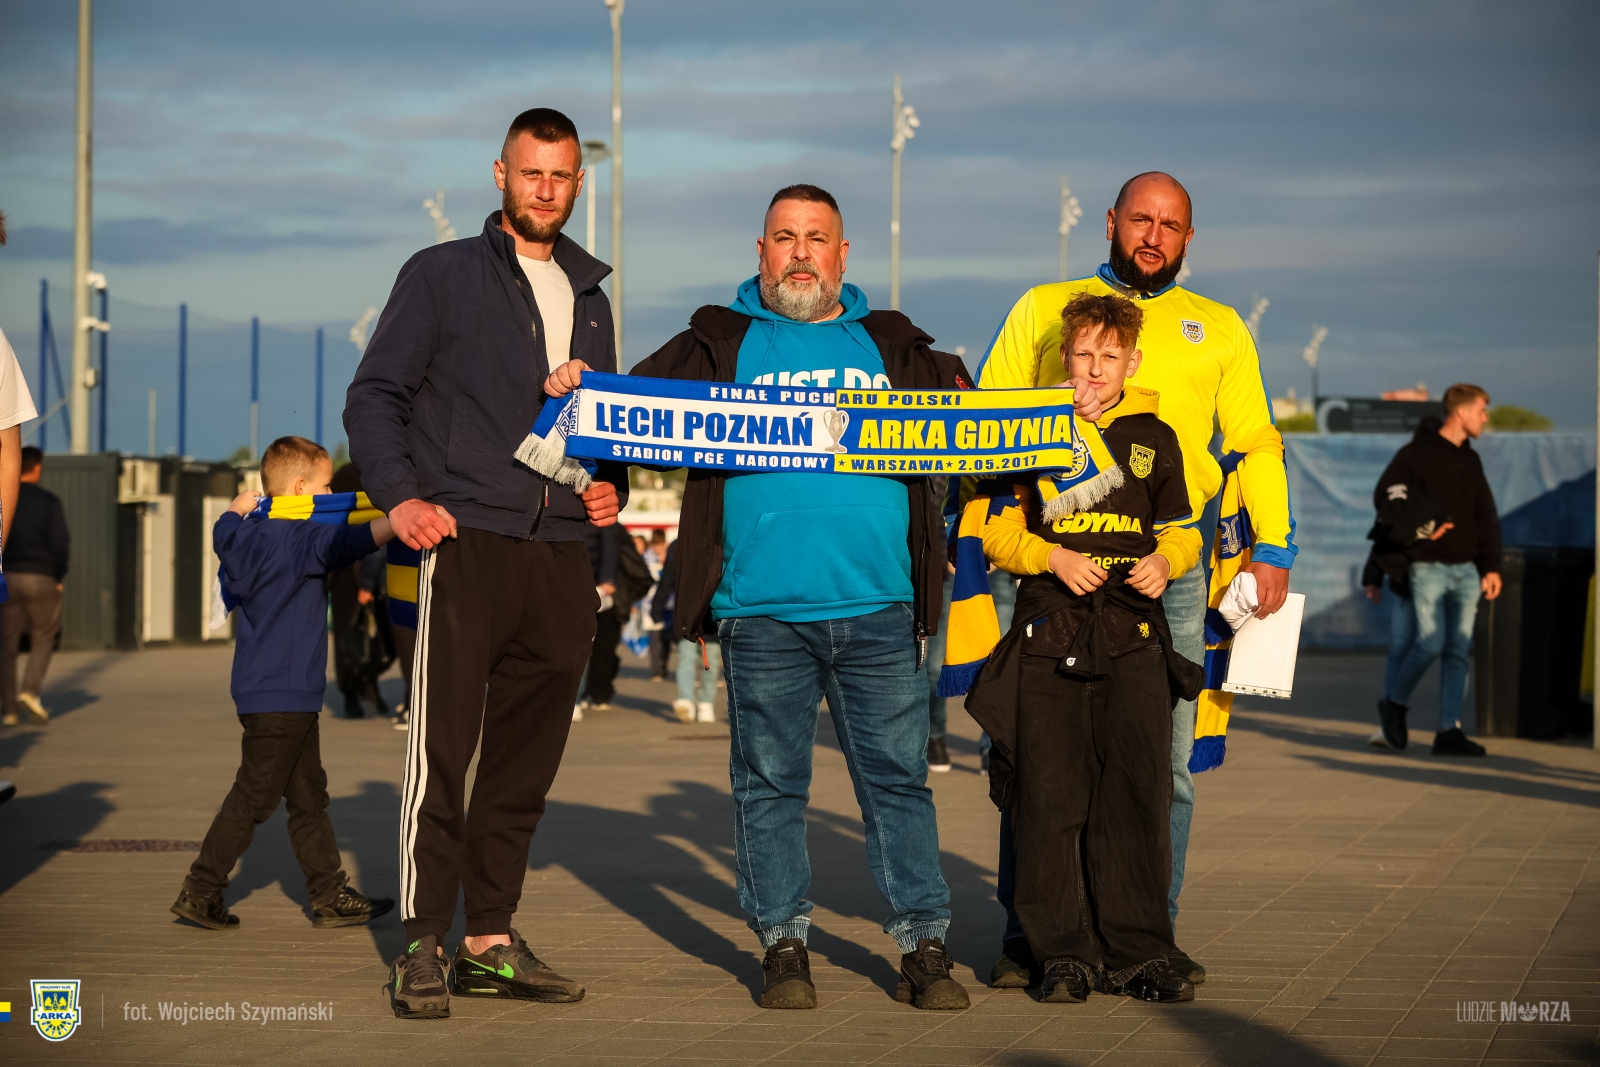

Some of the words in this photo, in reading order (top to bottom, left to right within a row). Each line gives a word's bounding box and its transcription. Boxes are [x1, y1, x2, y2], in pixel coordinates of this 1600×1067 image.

[710, 386, 768, 401] FINAŁ
[780, 389, 878, 405] PUCHARU
[888, 394, 962, 405] POLSKI
[595, 402, 675, 439] LECH
[684, 411, 813, 447] POZNAŃ
[858, 419, 947, 449] ARKA
[954, 414, 1072, 449] GDYNIA
[612, 444, 683, 462] STADION
[694, 451, 724, 465] PGE
[735, 455, 829, 469] NARODOWY
[851, 459, 944, 471] WARSZAWA
[958, 455, 1038, 471] 2.05.2017
[1052, 512, 1143, 535] GDYNIA
